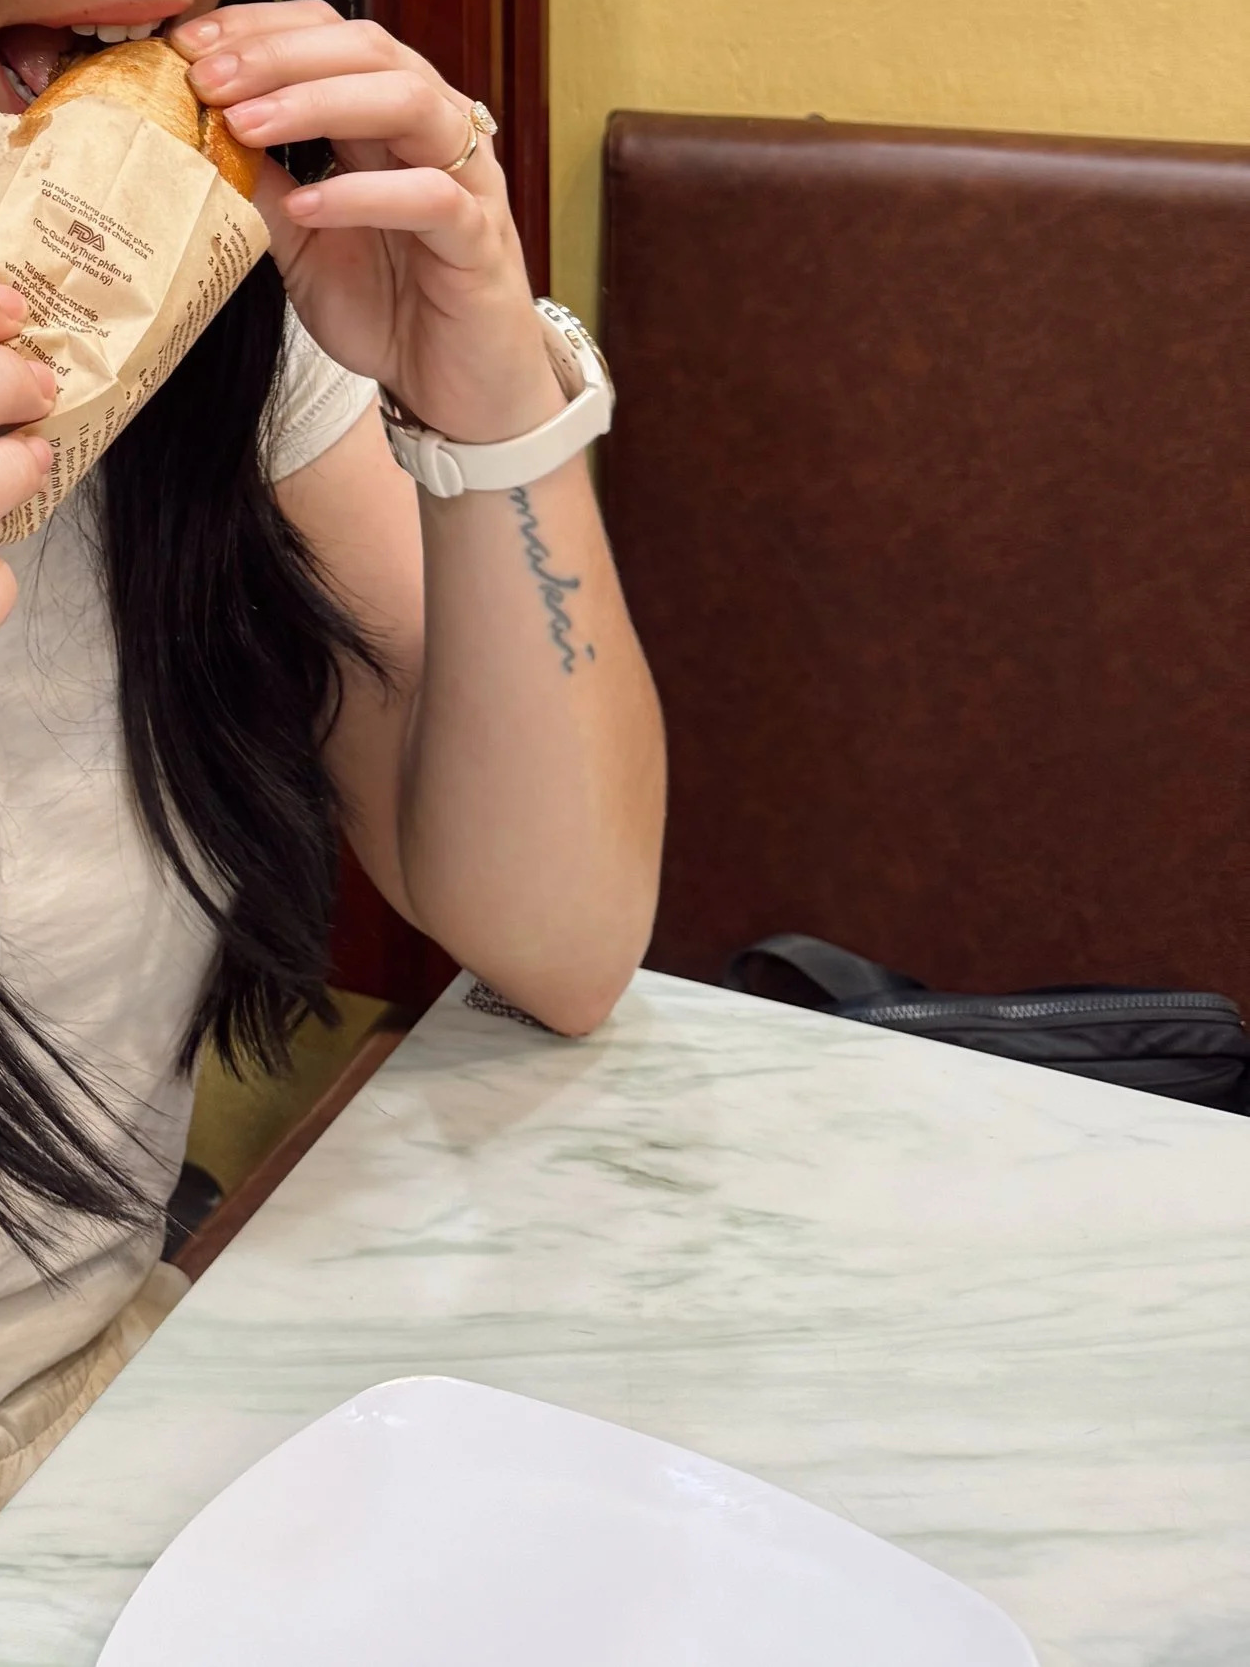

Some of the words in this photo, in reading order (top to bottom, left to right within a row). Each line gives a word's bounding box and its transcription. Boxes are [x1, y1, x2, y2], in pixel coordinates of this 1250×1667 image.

[51, 194, 77, 213] chứng
[77, 208, 98, 224] nhận
[54, 185, 70, 197] này
[79, 200, 100, 217] dụng
[99, 214, 117, 227] giấy
[116, 223, 133, 240] thực
[67, 219, 105, 252] FDA
[48, 229, 70, 248] Quản
[78, 246, 99, 263] Thực
[96, 259, 122, 277] phẩm
[122, 272, 132, 283] và
[59, 251, 82, 269] phẩm
[81, 262, 99, 278] Hoa
[24, 260, 36, 275] Túi
[82, 307, 99, 322] tiếp
[28, 294, 39, 307] An
[30, 344, 57, 369] made
[56, 365, 71, 377] of
